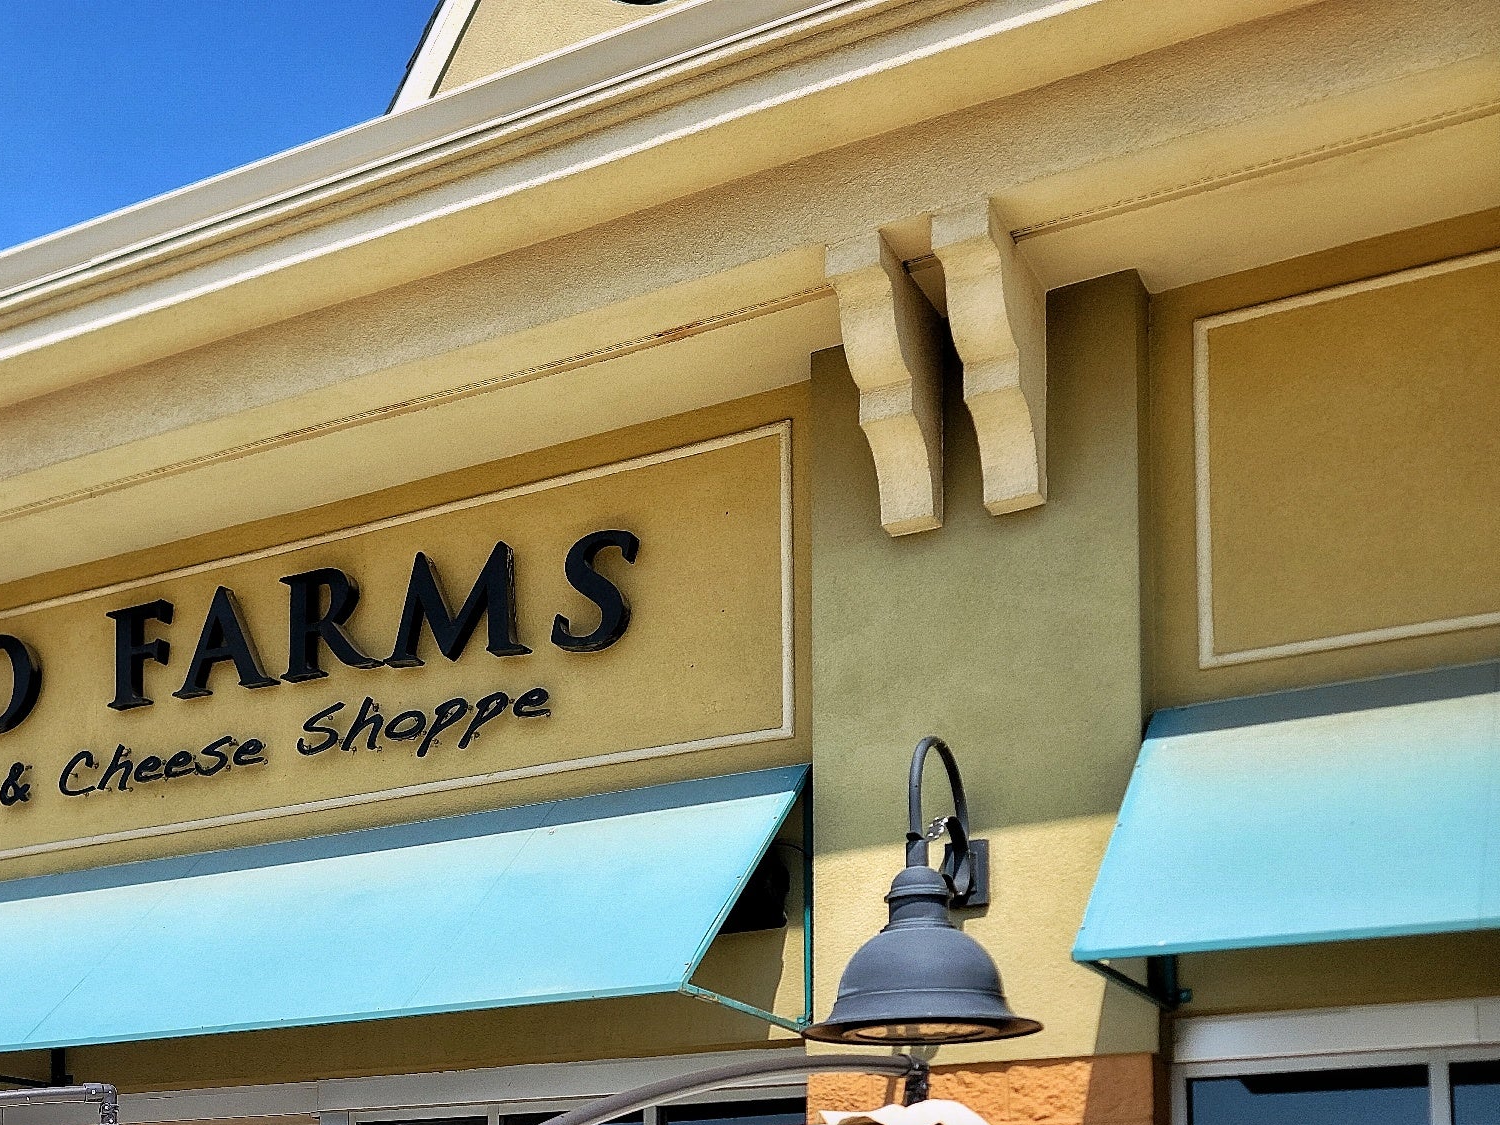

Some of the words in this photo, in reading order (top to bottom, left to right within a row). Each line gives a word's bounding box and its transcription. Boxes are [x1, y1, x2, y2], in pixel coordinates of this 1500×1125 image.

[106, 530, 640, 710] FARMS
[0, 762, 31, 806] &
[58, 735, 267, 798] Cheese
[296, 686, 552, 758] Shoppe
